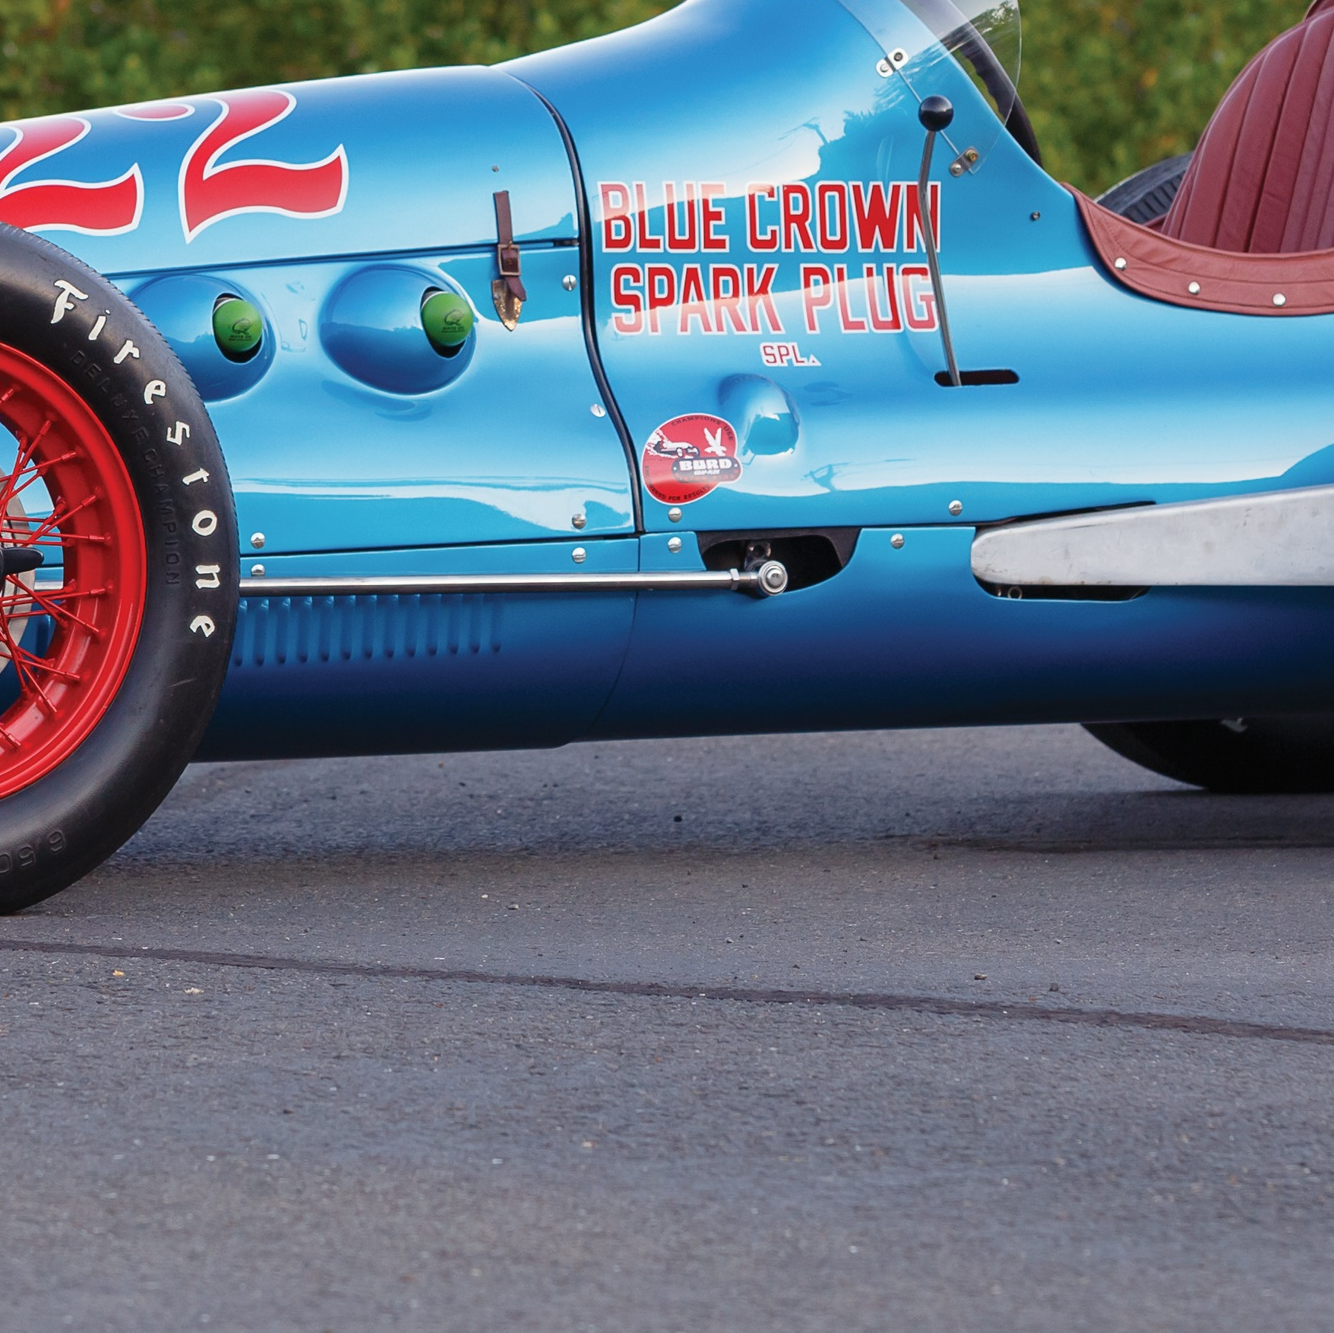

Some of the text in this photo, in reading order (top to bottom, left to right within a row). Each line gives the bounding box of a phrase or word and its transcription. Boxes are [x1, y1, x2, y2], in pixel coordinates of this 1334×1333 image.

[597, 180, 941, 254] BLUE CROWN
[610, 263, 940, 335] SPARK PLUG
[50, 279, 221, 639] Firestone
[141, 447, 182, 586] CHAMPION
